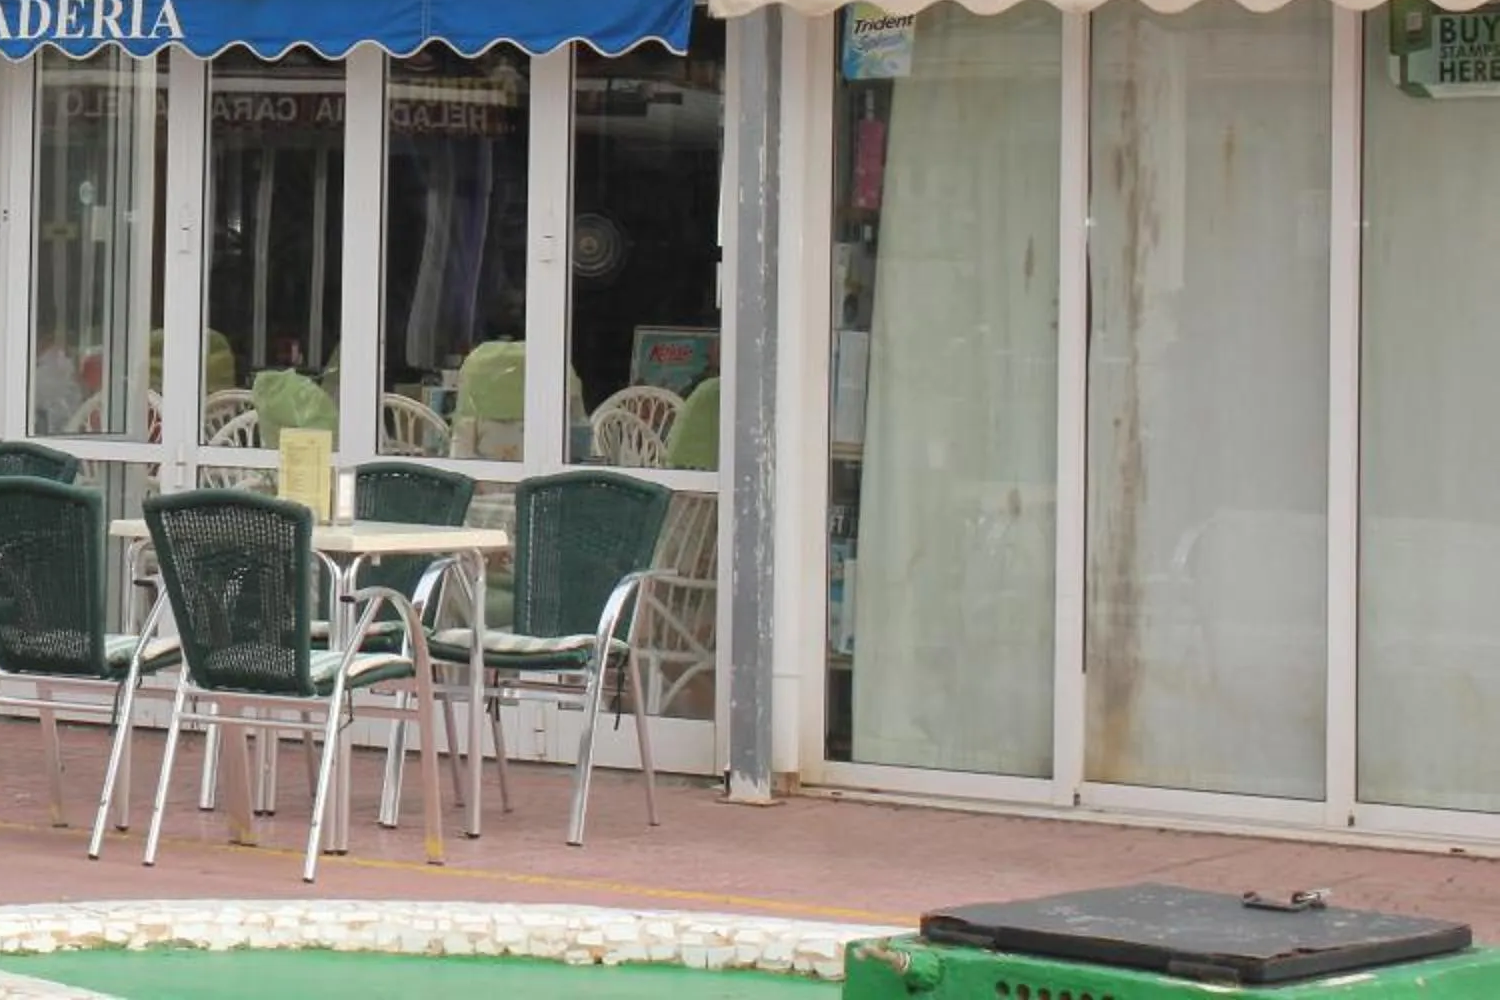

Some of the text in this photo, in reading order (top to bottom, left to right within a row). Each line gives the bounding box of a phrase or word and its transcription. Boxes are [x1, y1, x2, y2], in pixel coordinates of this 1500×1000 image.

[853, 13, 915, 35] Trident
[1439, 15, 1500, 44] BUY
[1439, 59, 1500, 83] HERE
